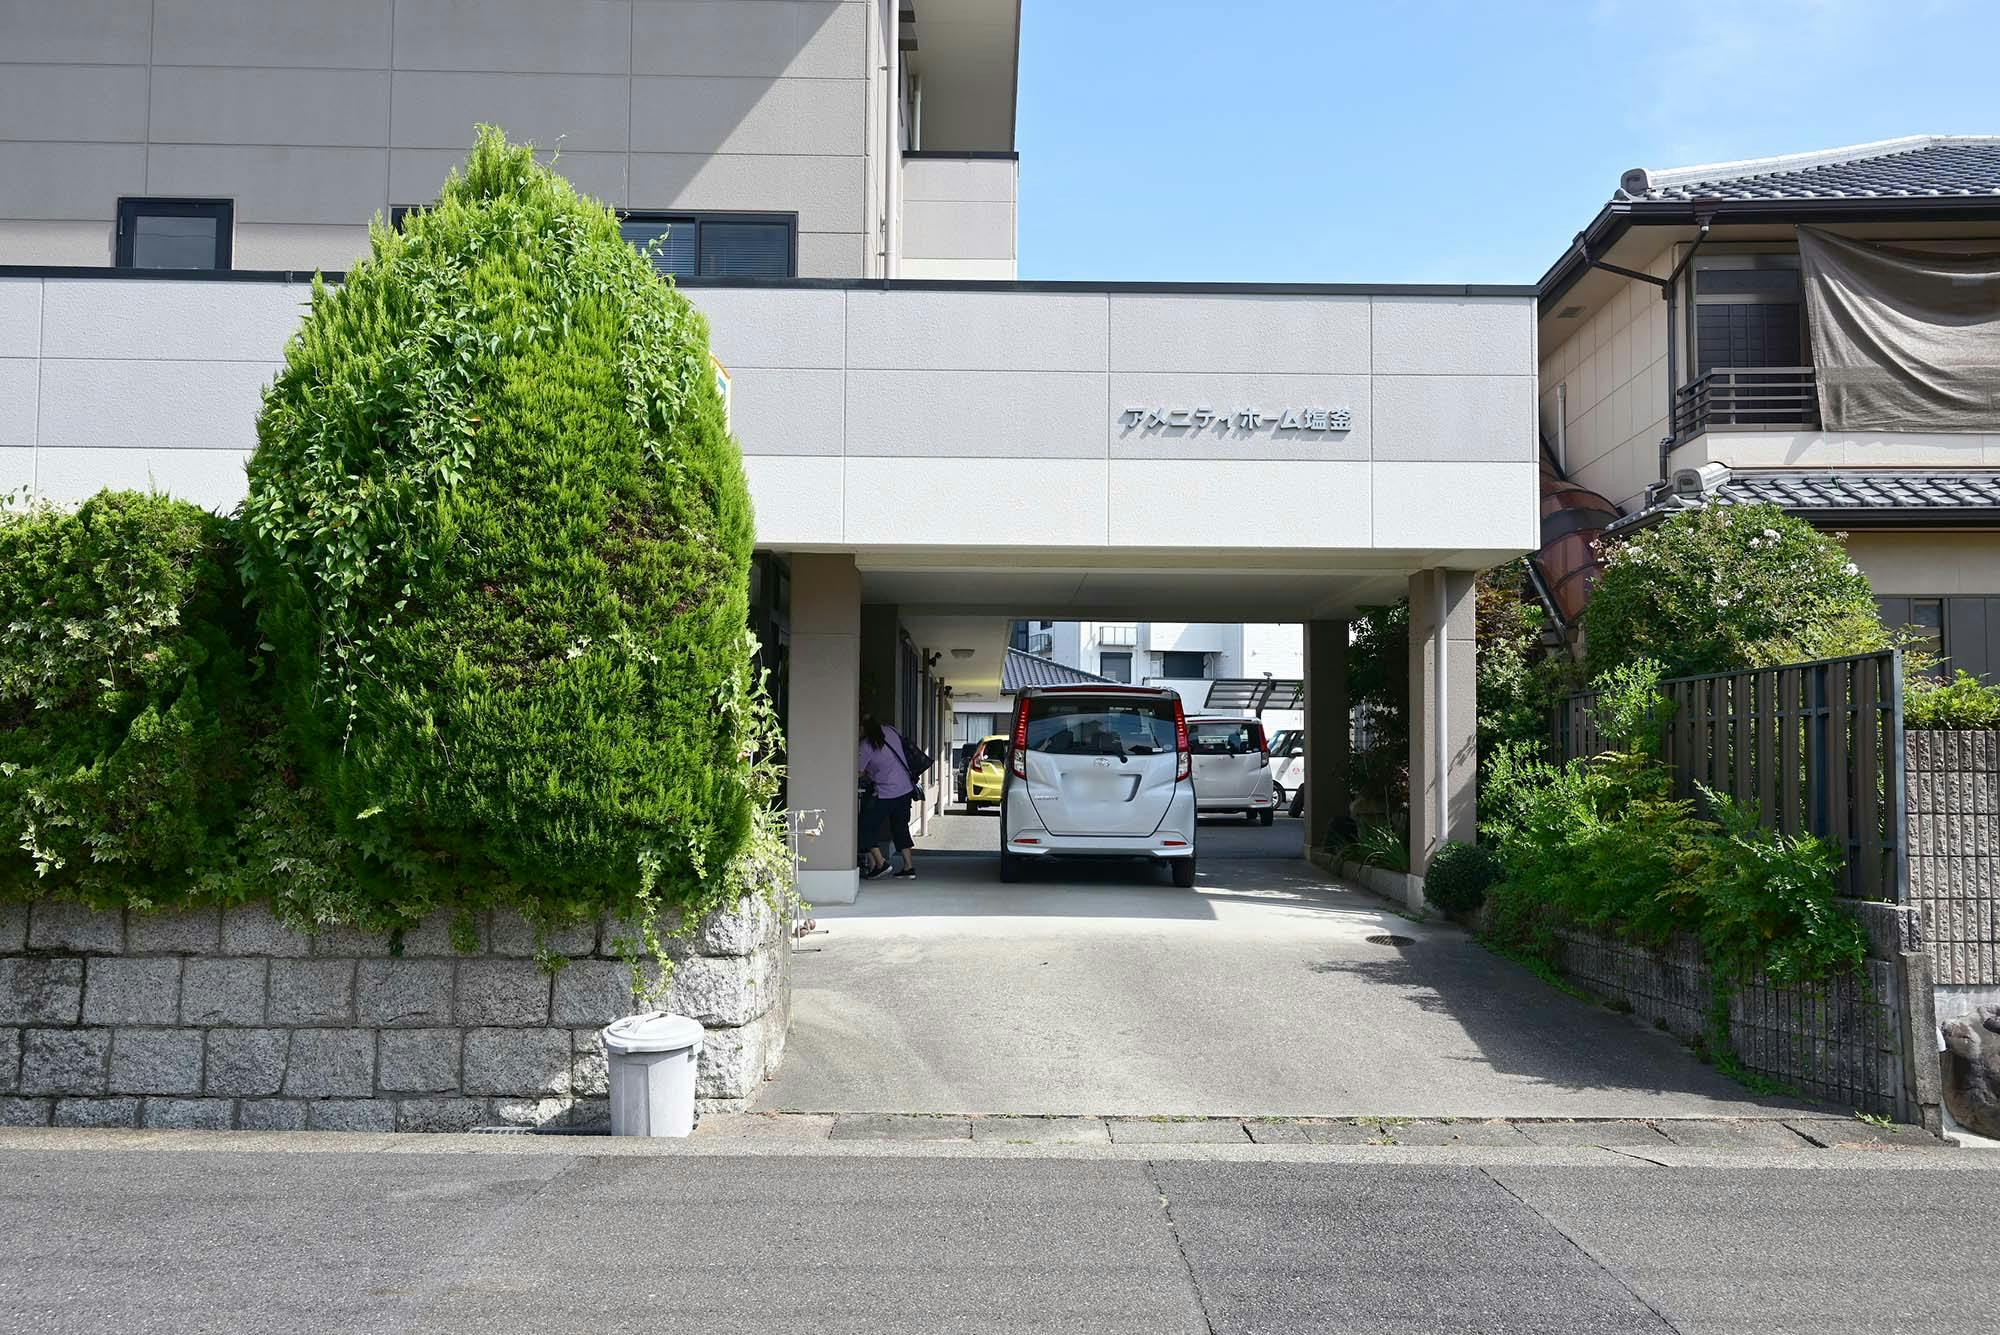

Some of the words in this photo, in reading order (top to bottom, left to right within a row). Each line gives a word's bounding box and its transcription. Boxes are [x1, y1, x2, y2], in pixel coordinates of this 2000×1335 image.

[1125, 407, 1352, 432] アメニティホーム塩釜
